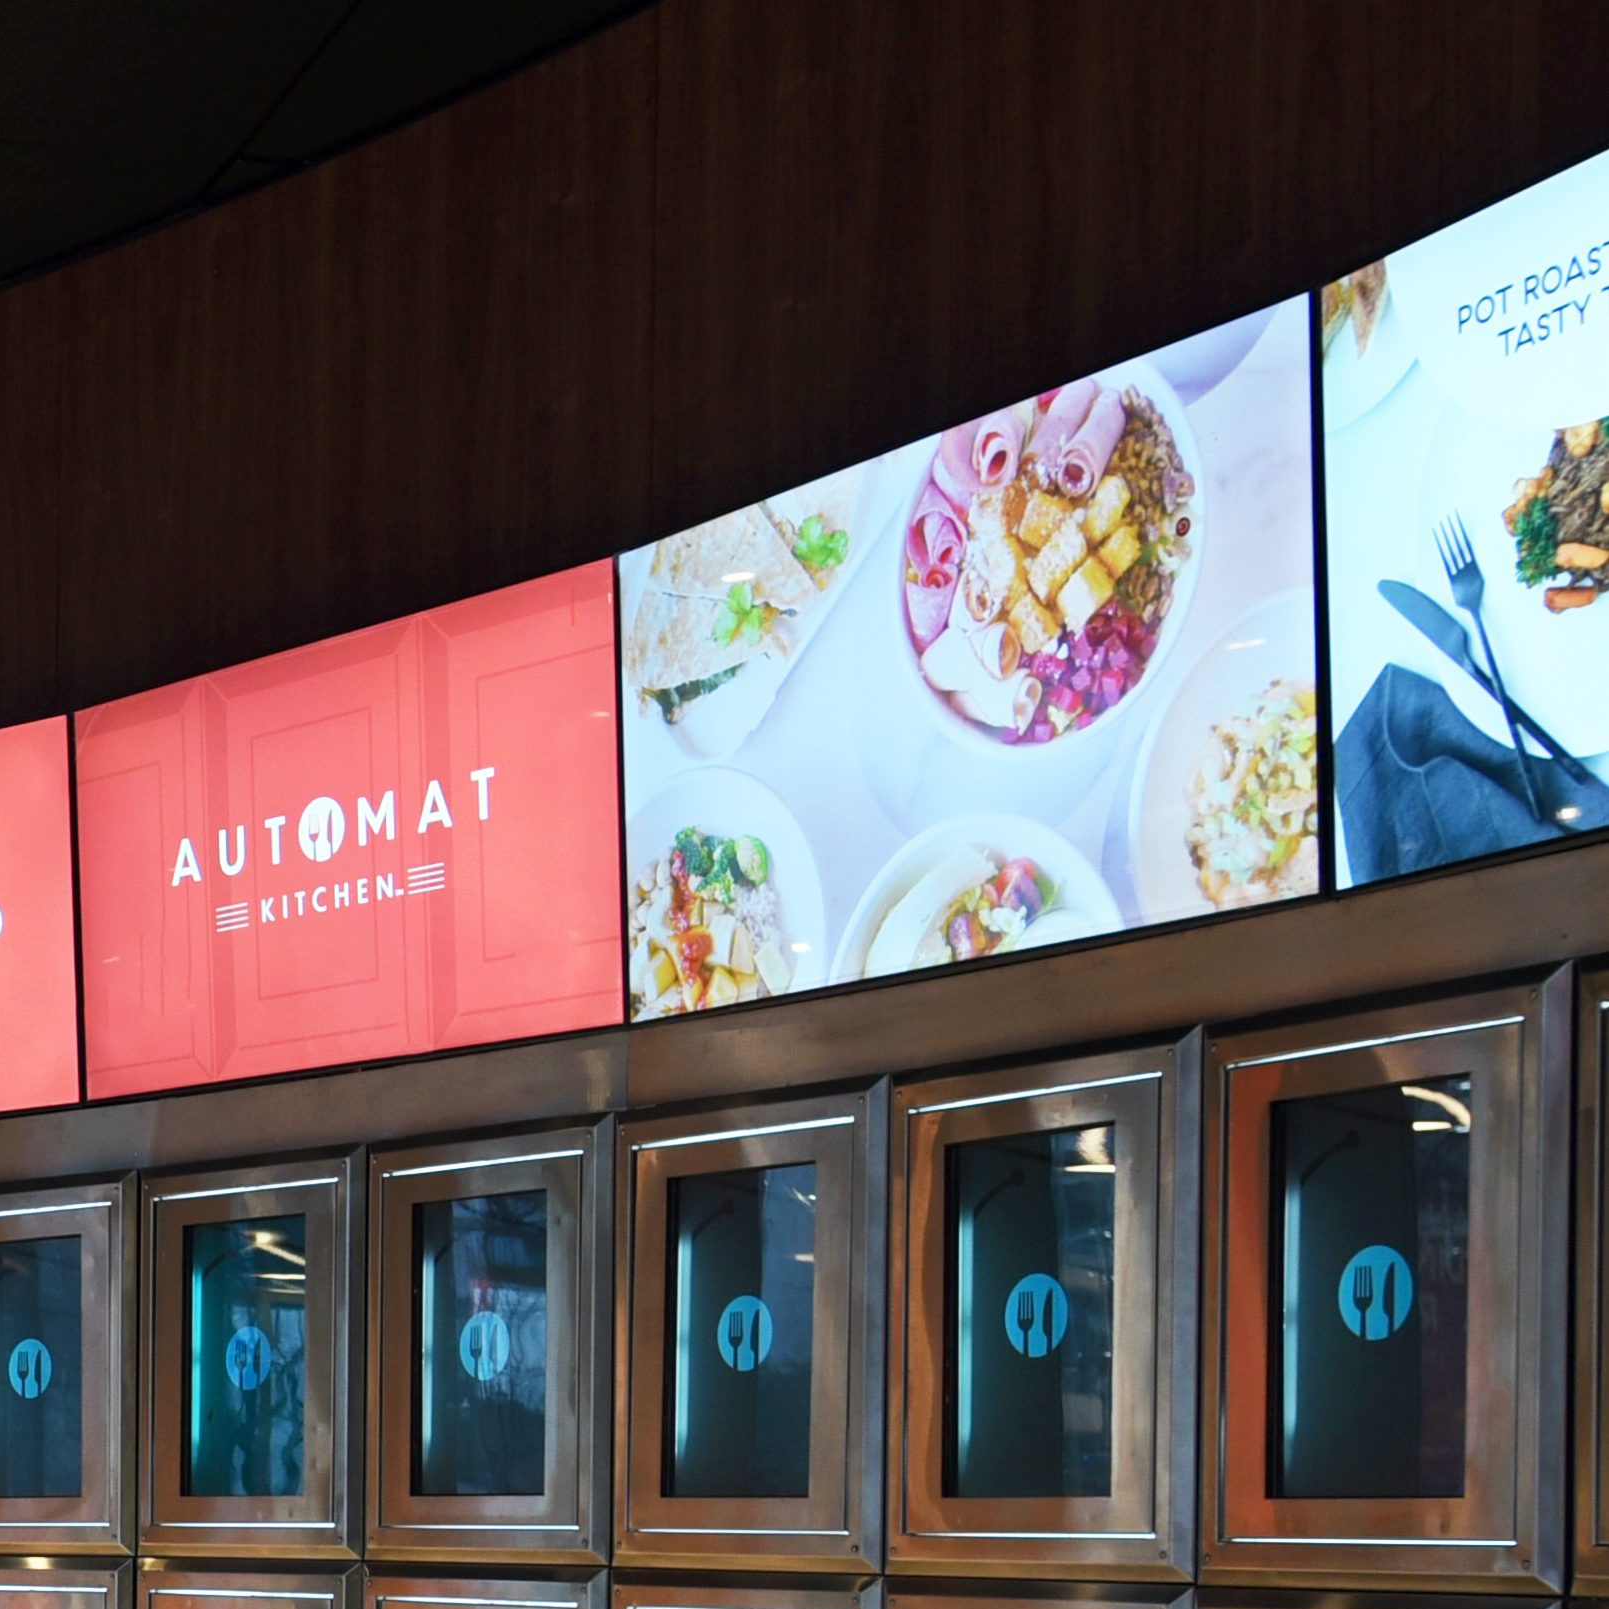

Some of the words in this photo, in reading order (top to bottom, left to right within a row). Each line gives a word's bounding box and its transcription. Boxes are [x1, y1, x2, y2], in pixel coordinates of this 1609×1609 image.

[1458, 283, 1514, 334] POT
[1524, 241, 1609, 305] ROAS
[1497, 293, 1592, 357] TASTY
[171, 766, 495, 887] AUTOMAT
